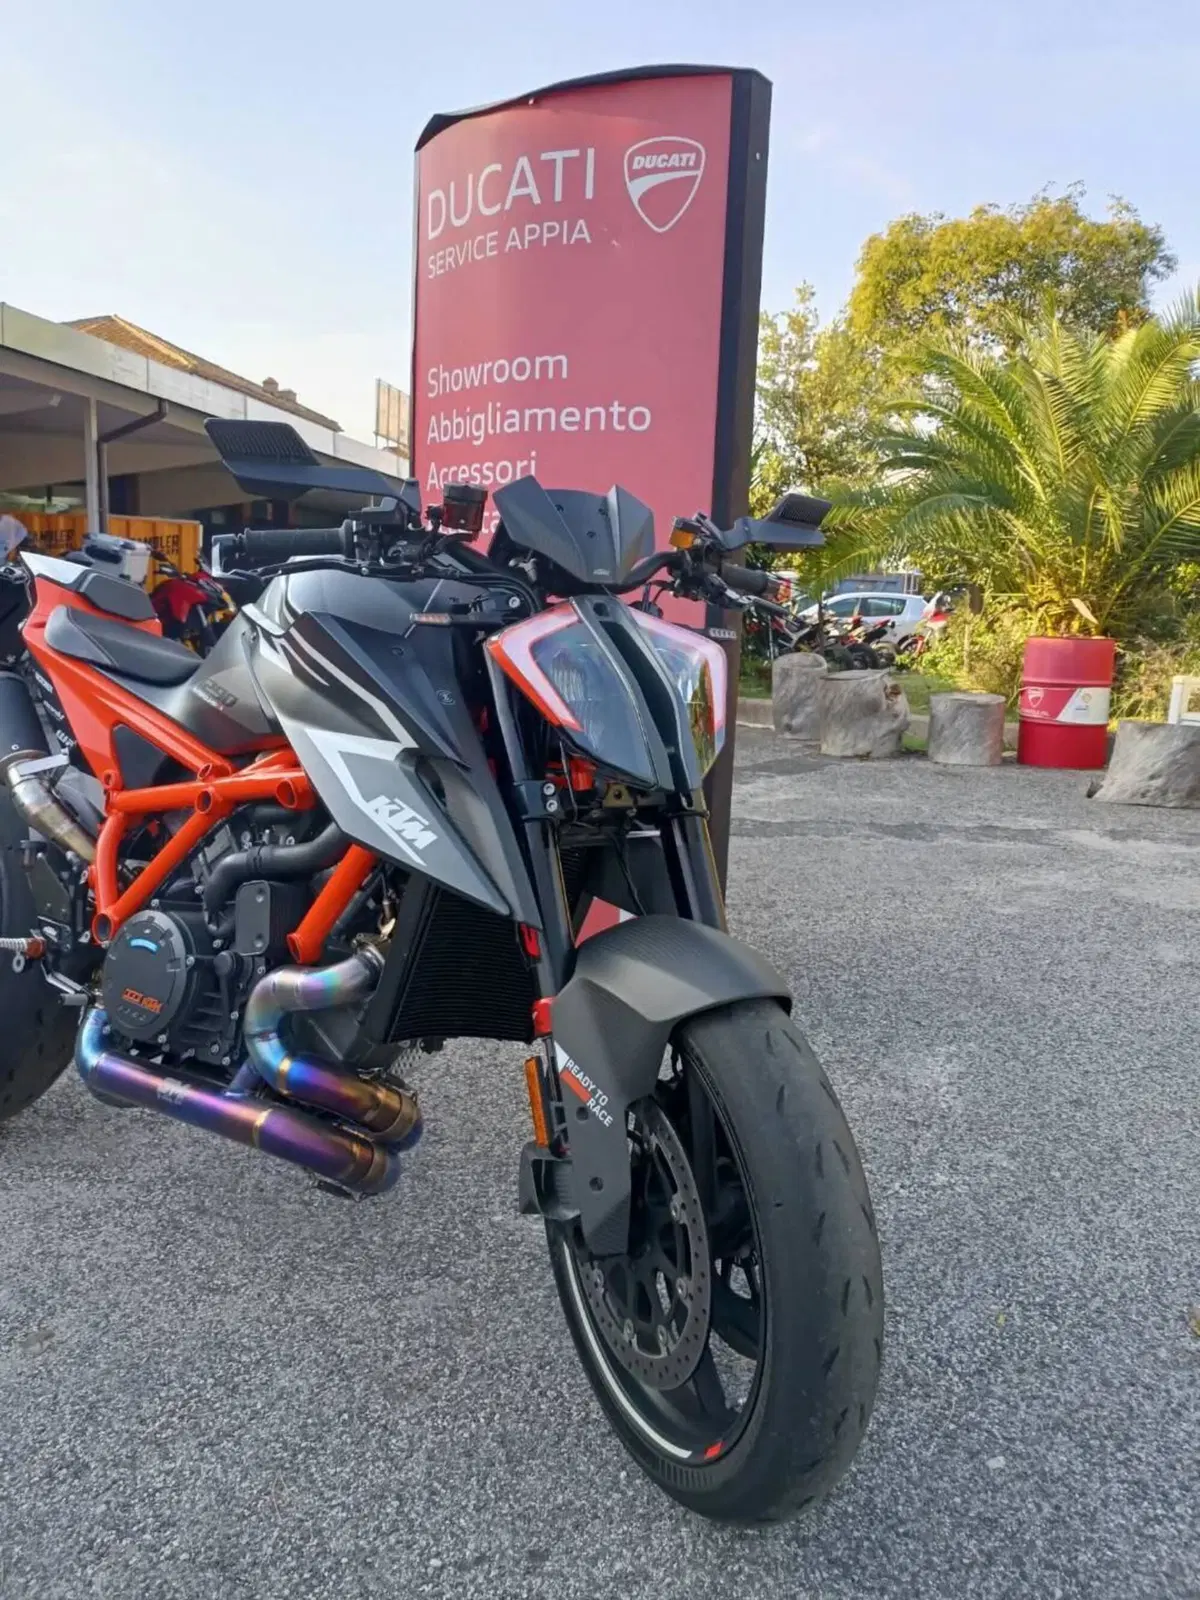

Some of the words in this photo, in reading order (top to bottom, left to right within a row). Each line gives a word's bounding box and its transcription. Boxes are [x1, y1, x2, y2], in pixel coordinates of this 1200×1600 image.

[632, 152, 697, 171] DUCATI
[427, 147, 595, 241] DUCATI
[427, 231, 499, 280] SERVICE
[504, 218, 592, 254] APPIA
[426, 353, 569, 398] Showroom
[426, 400, 652, 446] Abbigliamento
[426, 450, 537, 492] Accessori
[365, 795, 438, 850] KTM
[566, 1059, 596, 1092] READY
[594, 1088, 609, 1107] TO
[586, 1097, 614, 1128] RACE
